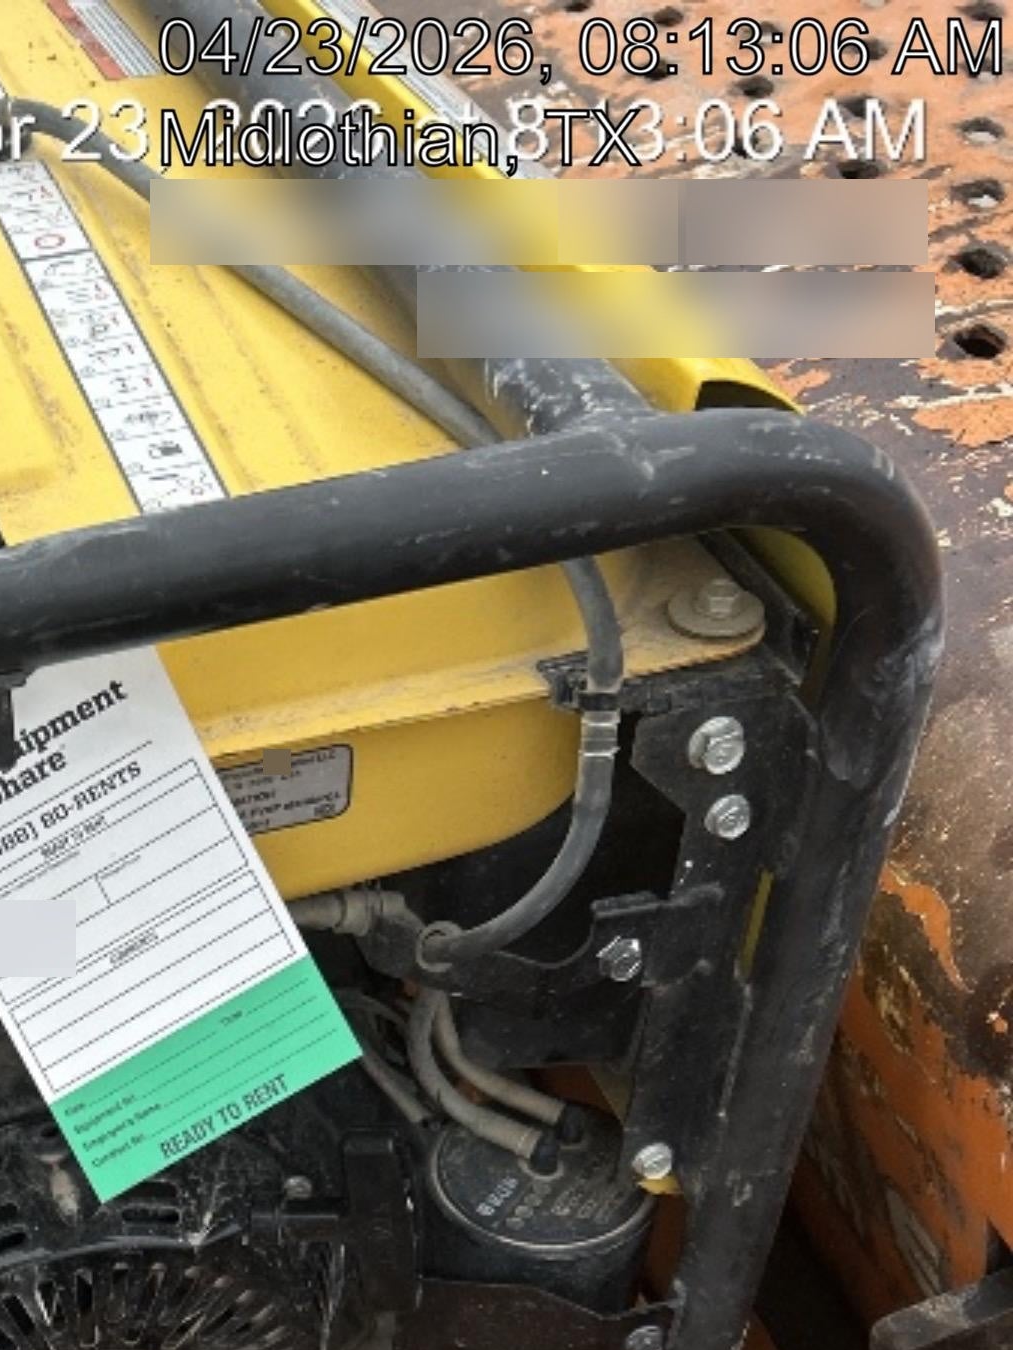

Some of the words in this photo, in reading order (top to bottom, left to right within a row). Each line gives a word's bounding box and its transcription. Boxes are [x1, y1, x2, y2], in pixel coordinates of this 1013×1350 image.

[160, 1115, 217, 1159] READY
[217, 1103, 241, 1124] TO
[241, 1073, 289, 1112] RENT
